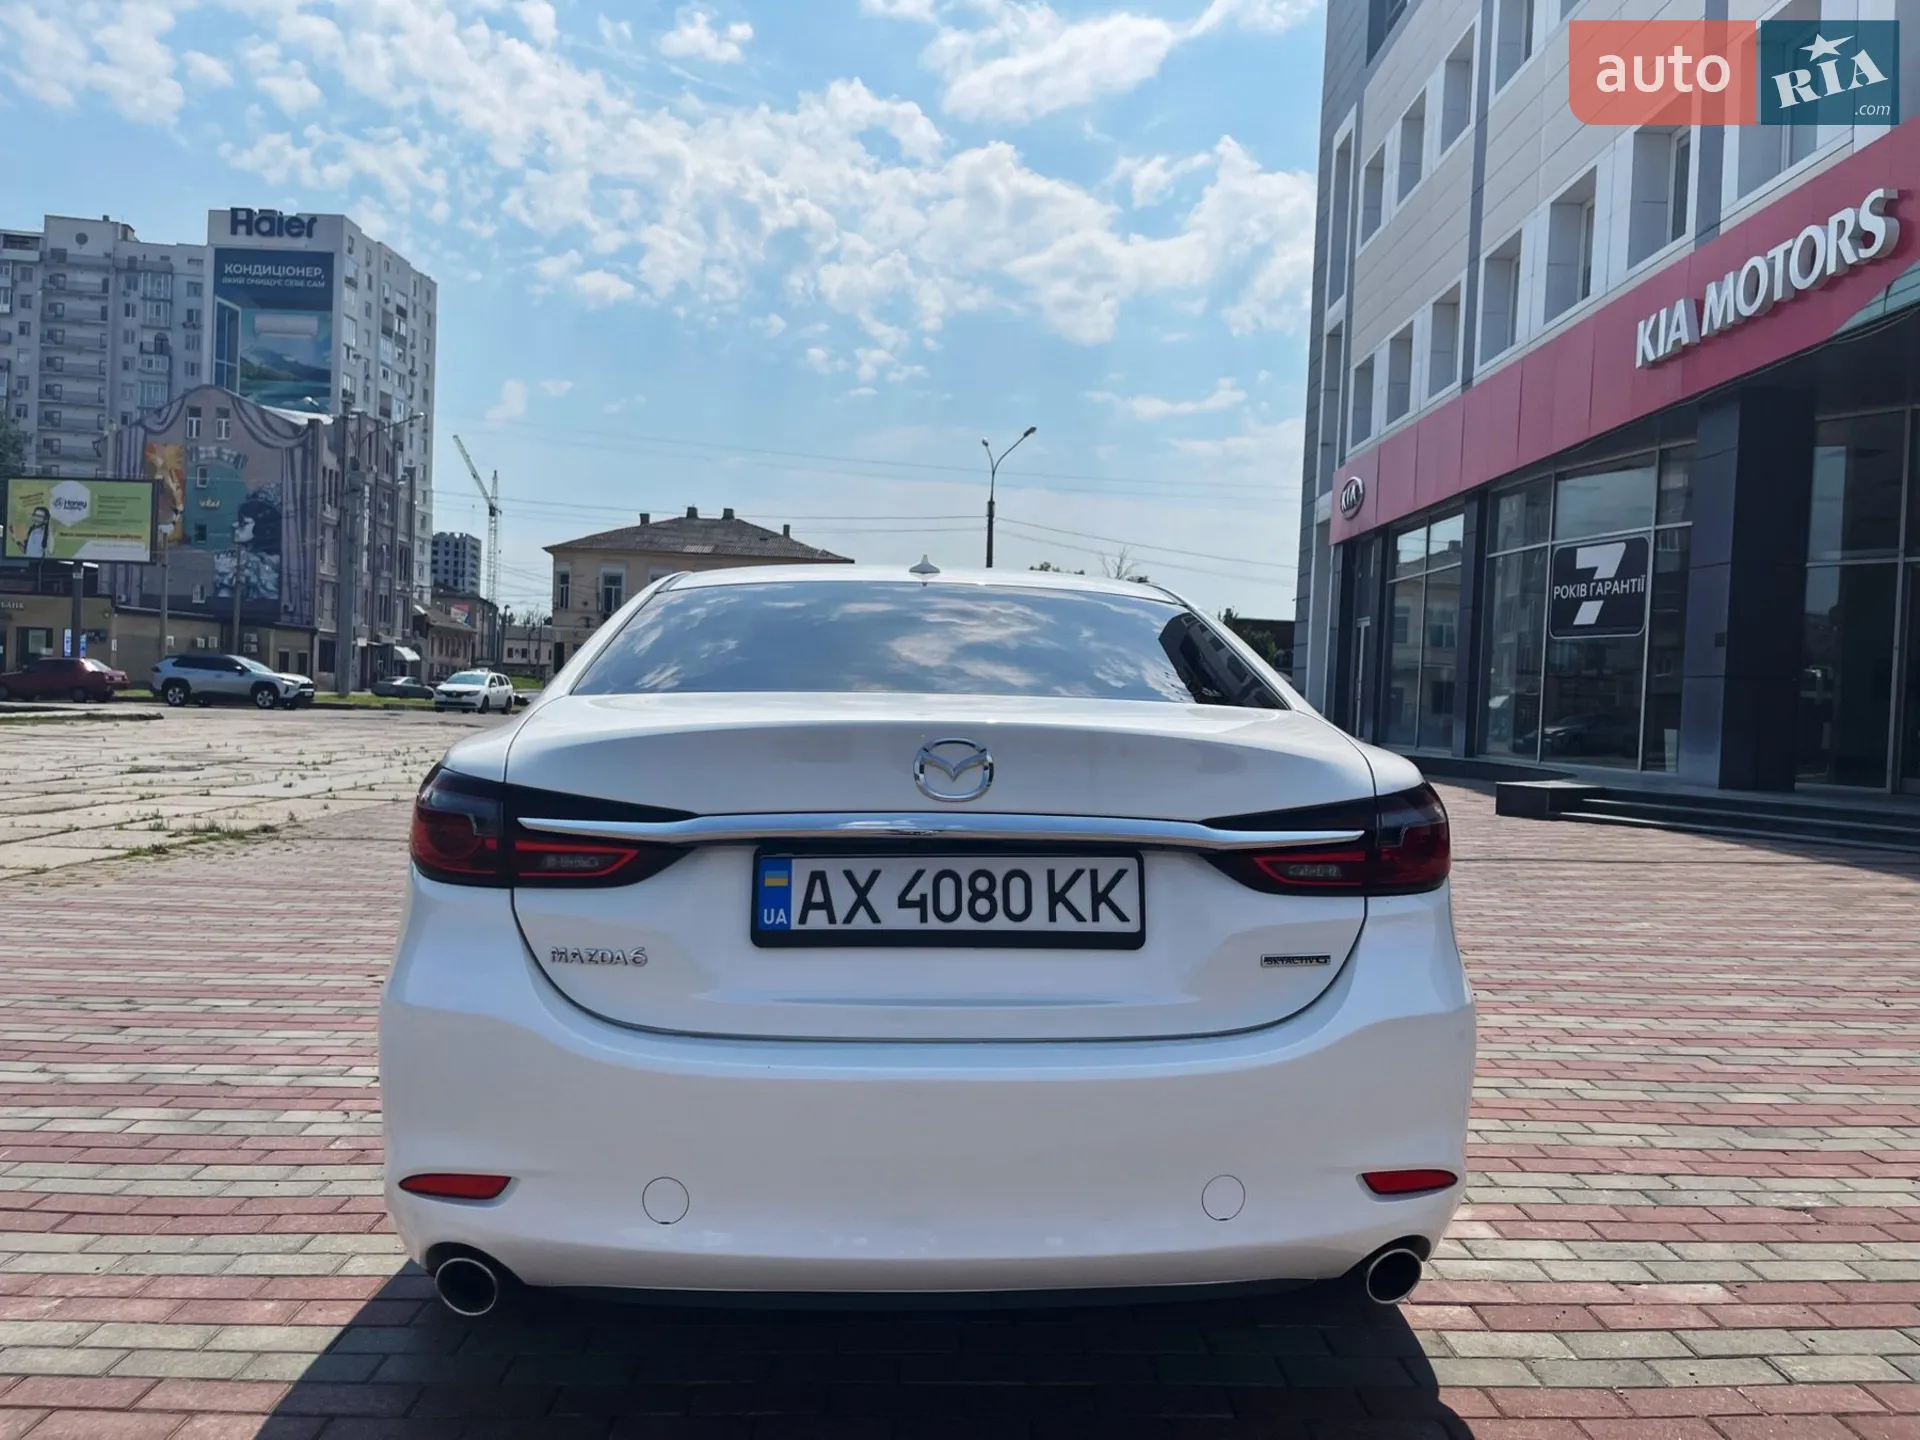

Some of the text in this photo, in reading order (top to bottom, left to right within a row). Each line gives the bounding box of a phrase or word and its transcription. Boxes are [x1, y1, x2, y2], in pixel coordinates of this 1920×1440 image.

[229, 207, 318, 239] Haier
[1635, 187, 1900, 368] KIA MOTORS
[1553, 574, 1646, 600] РОКІВ ГАРАНТІЇ
[1573, 541, 1627, 625] 7
[763, 908, 788, 926] UA
[798, 868, 1131, 925] AX 4080 KK
